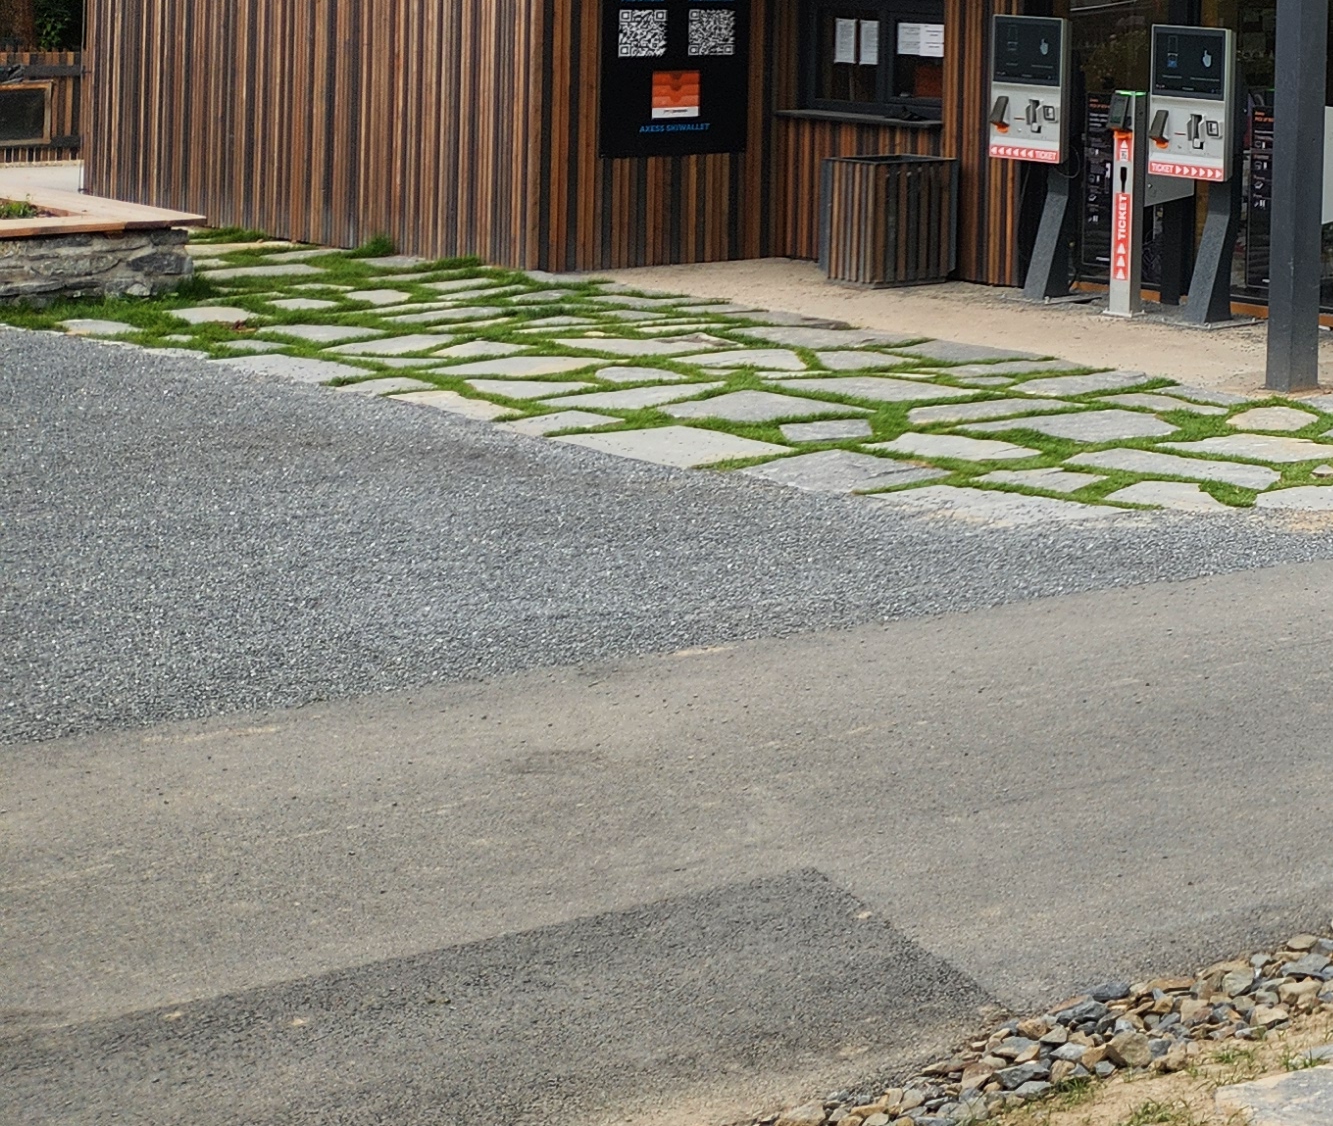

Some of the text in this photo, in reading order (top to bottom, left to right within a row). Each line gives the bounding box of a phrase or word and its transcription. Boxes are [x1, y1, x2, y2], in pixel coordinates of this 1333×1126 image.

[1034, 149, 1058, 162] TICKET
[1151, 162, 1174, 174] TICKET
[1117, 193, 1128, 241] TICKET
